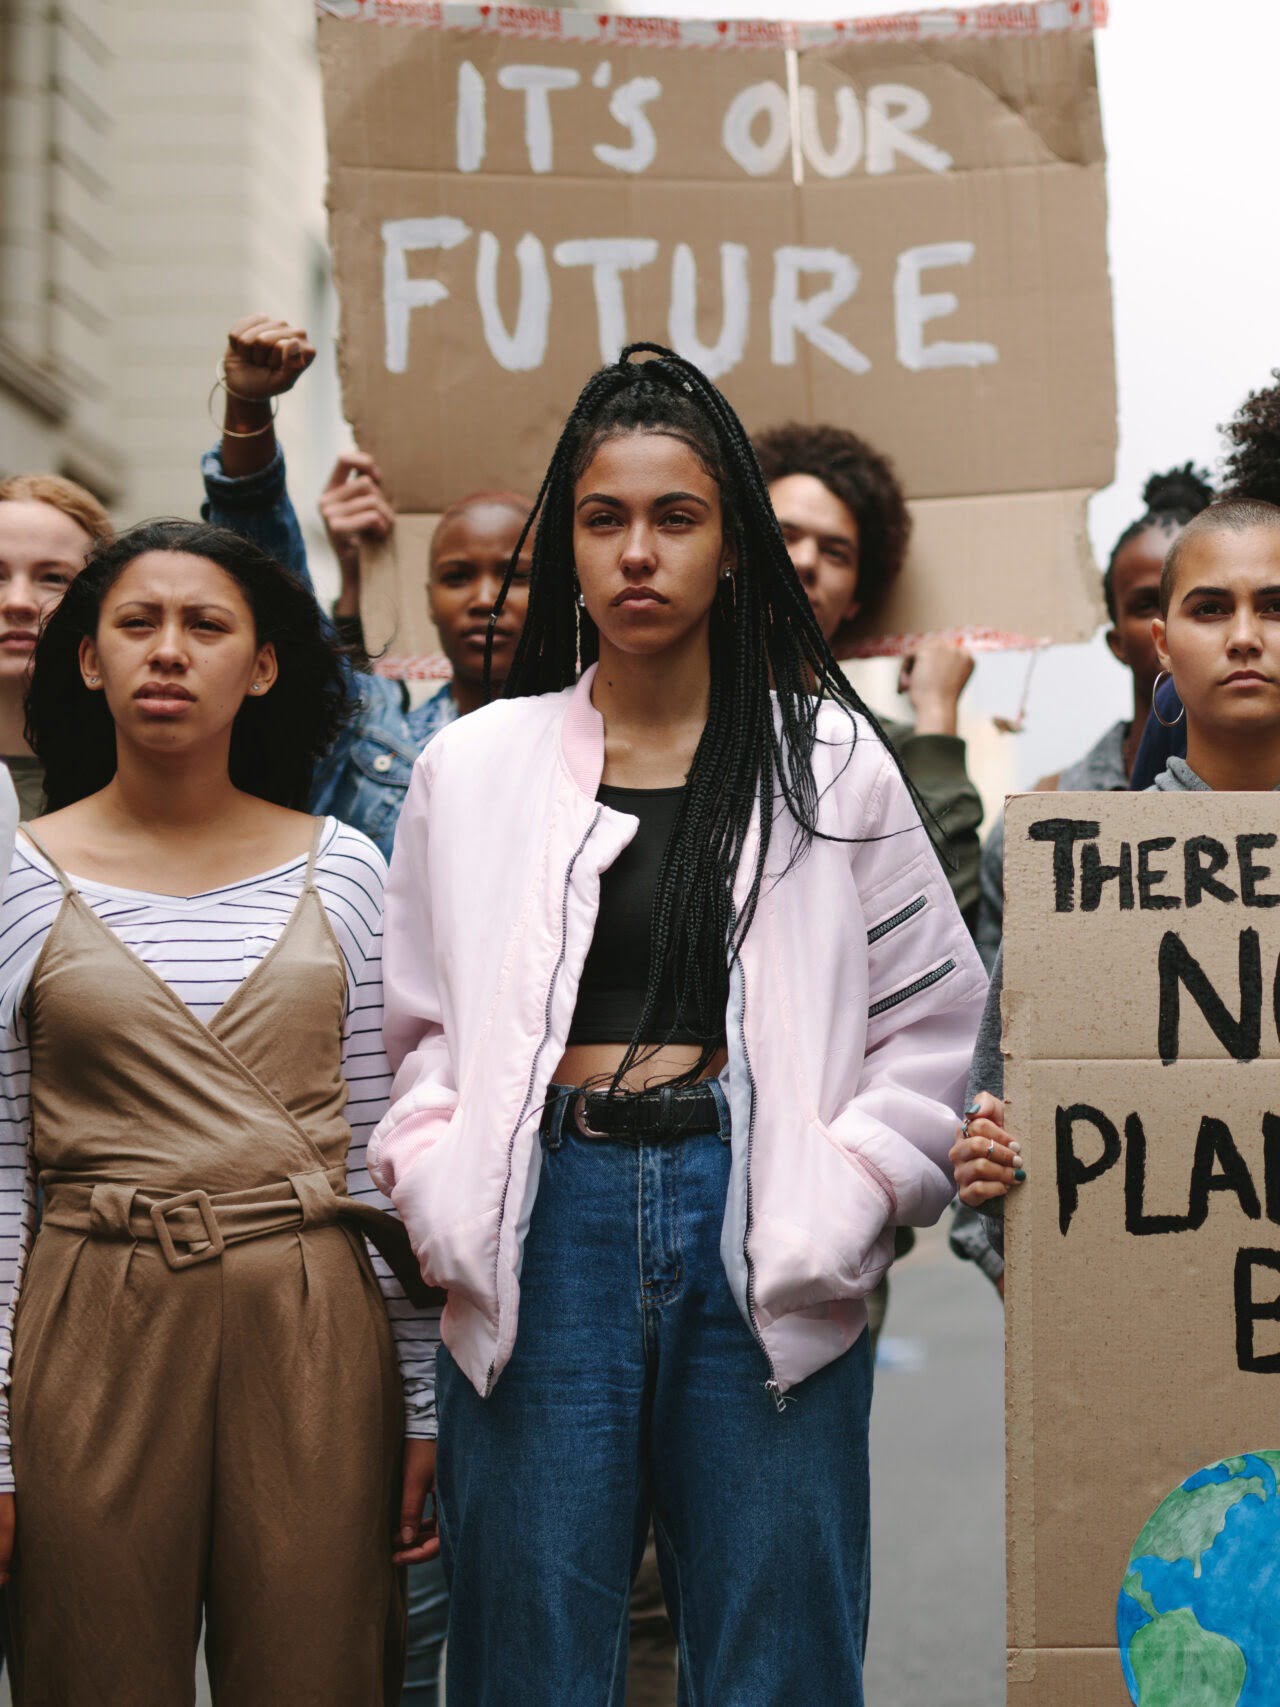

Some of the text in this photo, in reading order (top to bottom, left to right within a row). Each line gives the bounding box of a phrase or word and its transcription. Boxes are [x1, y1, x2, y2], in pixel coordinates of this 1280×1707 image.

[456, 60, 954, 177] IT'S OUR
[381, 217, 998, 380] FUTURE
